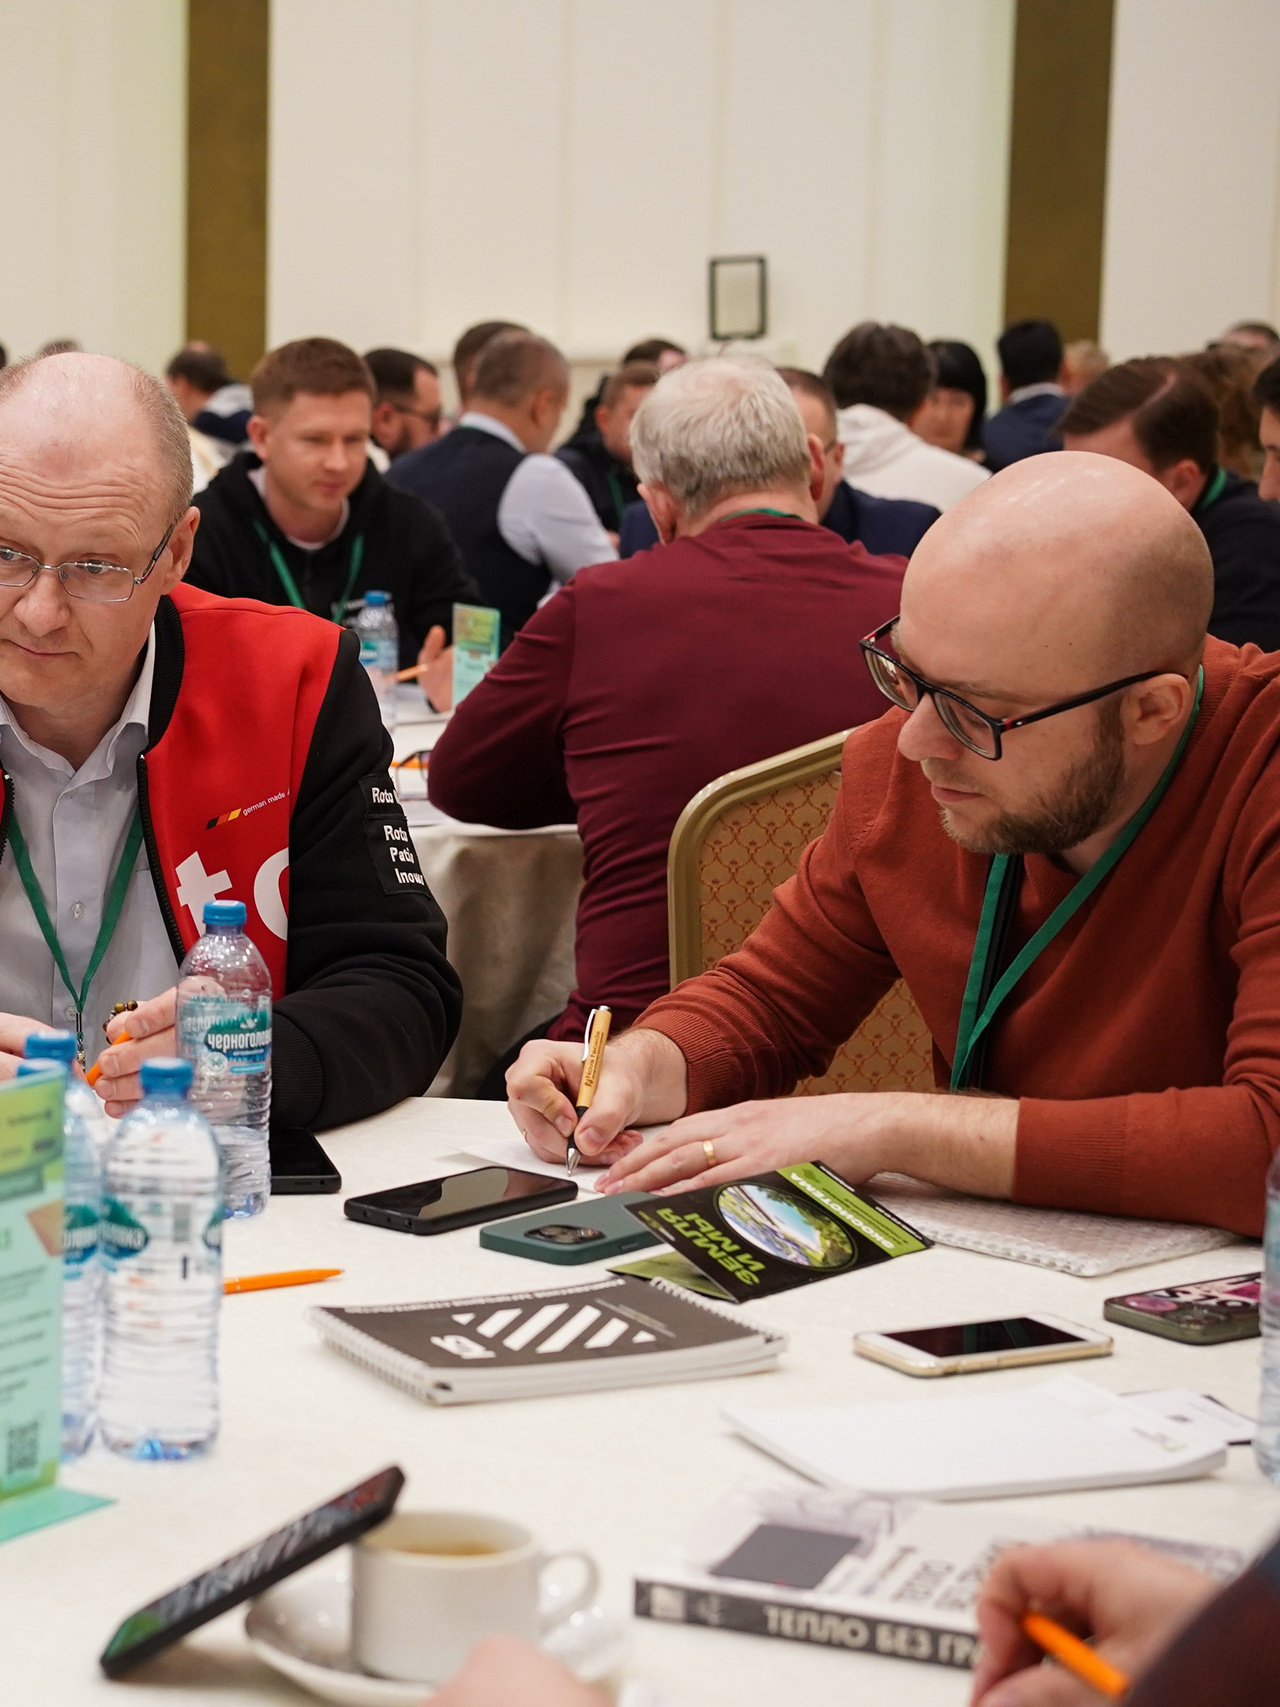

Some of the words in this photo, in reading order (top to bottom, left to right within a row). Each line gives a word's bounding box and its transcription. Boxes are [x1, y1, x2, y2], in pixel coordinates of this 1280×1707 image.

[242, 800, 268, 817] german
[267, 791, 286, 804] made
[656, 1207, 760, 1286] ЗЕМЛЯ
[683, 1212, 741, 1253] МЫ
[735, 1252, 767, 1273] И
[762, 1604, 870, 1649] ТЕПЛО
[875, 1621, 933, 1661] БЕЗ
